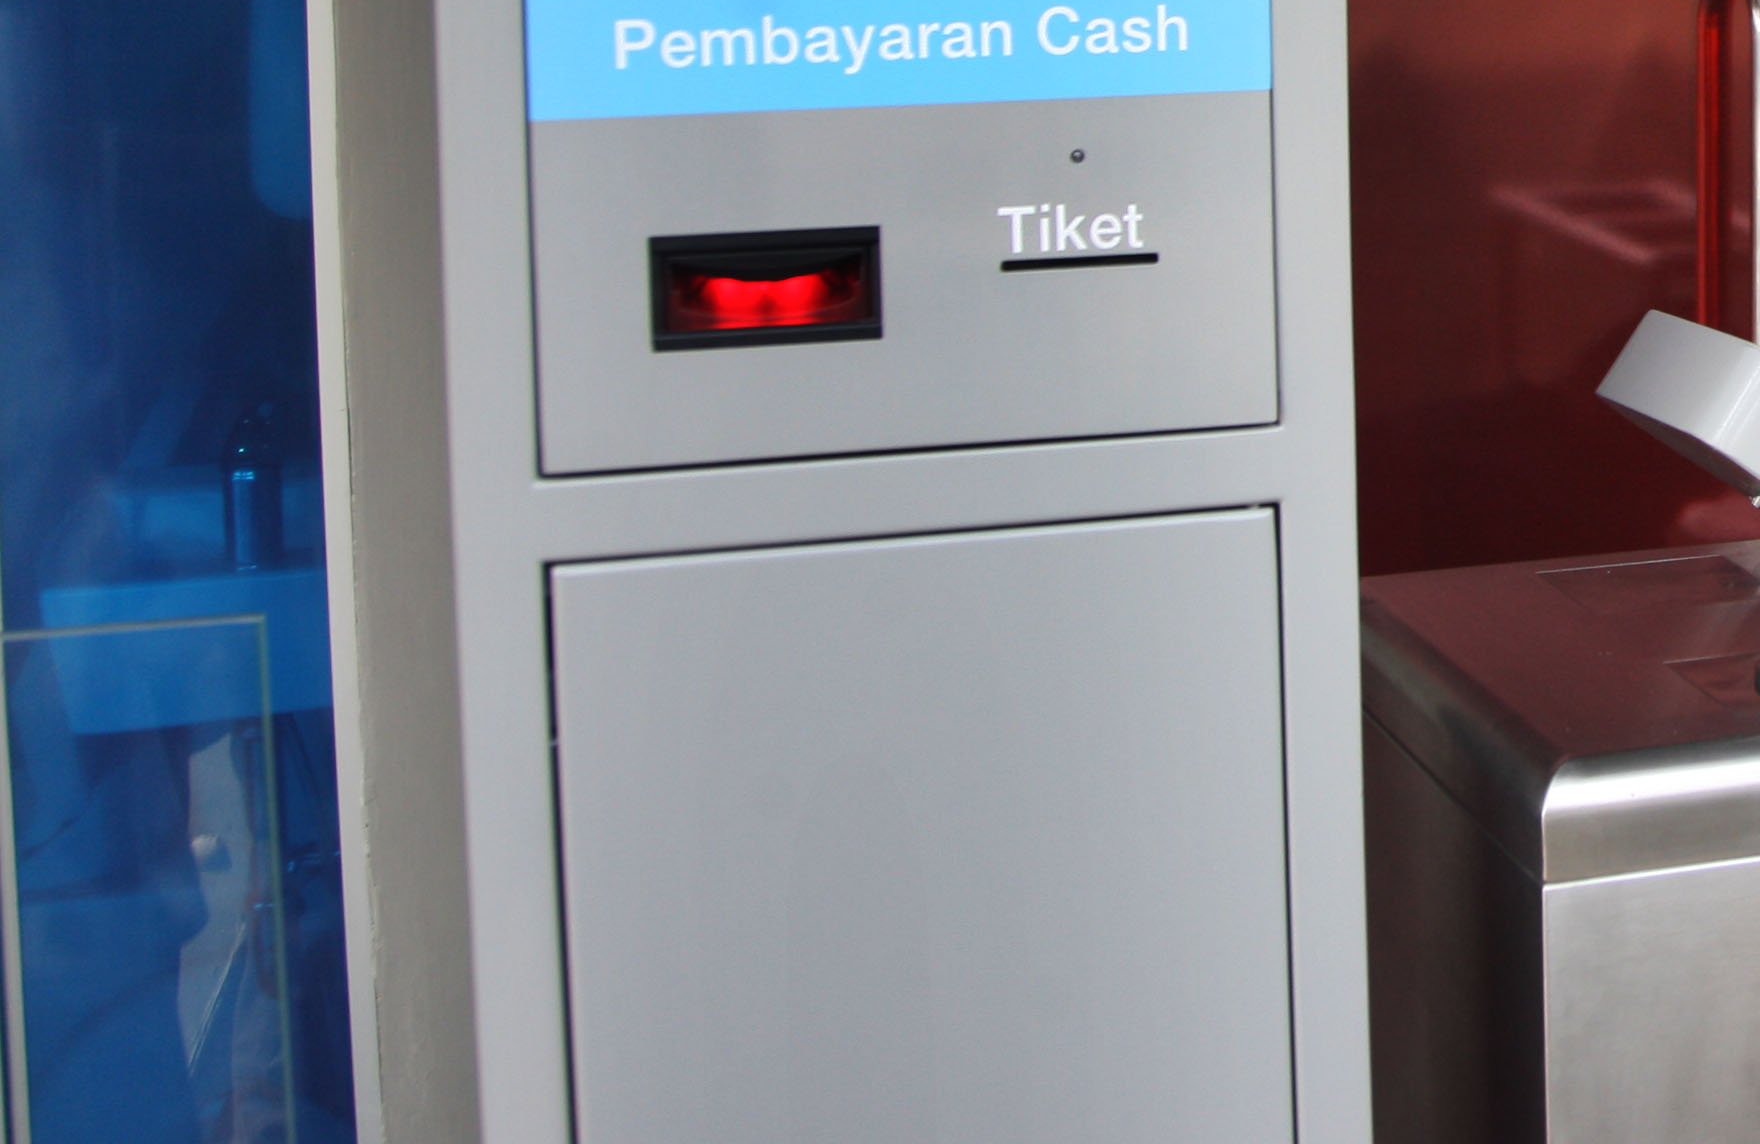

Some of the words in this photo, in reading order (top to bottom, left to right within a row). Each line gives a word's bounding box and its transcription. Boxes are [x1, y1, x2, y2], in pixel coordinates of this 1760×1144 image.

[613, 16, 1014, 74] Pembayaran
[1036, 5, 1189, 56] Cash
[997, 203, 1144, 254] Tiket
